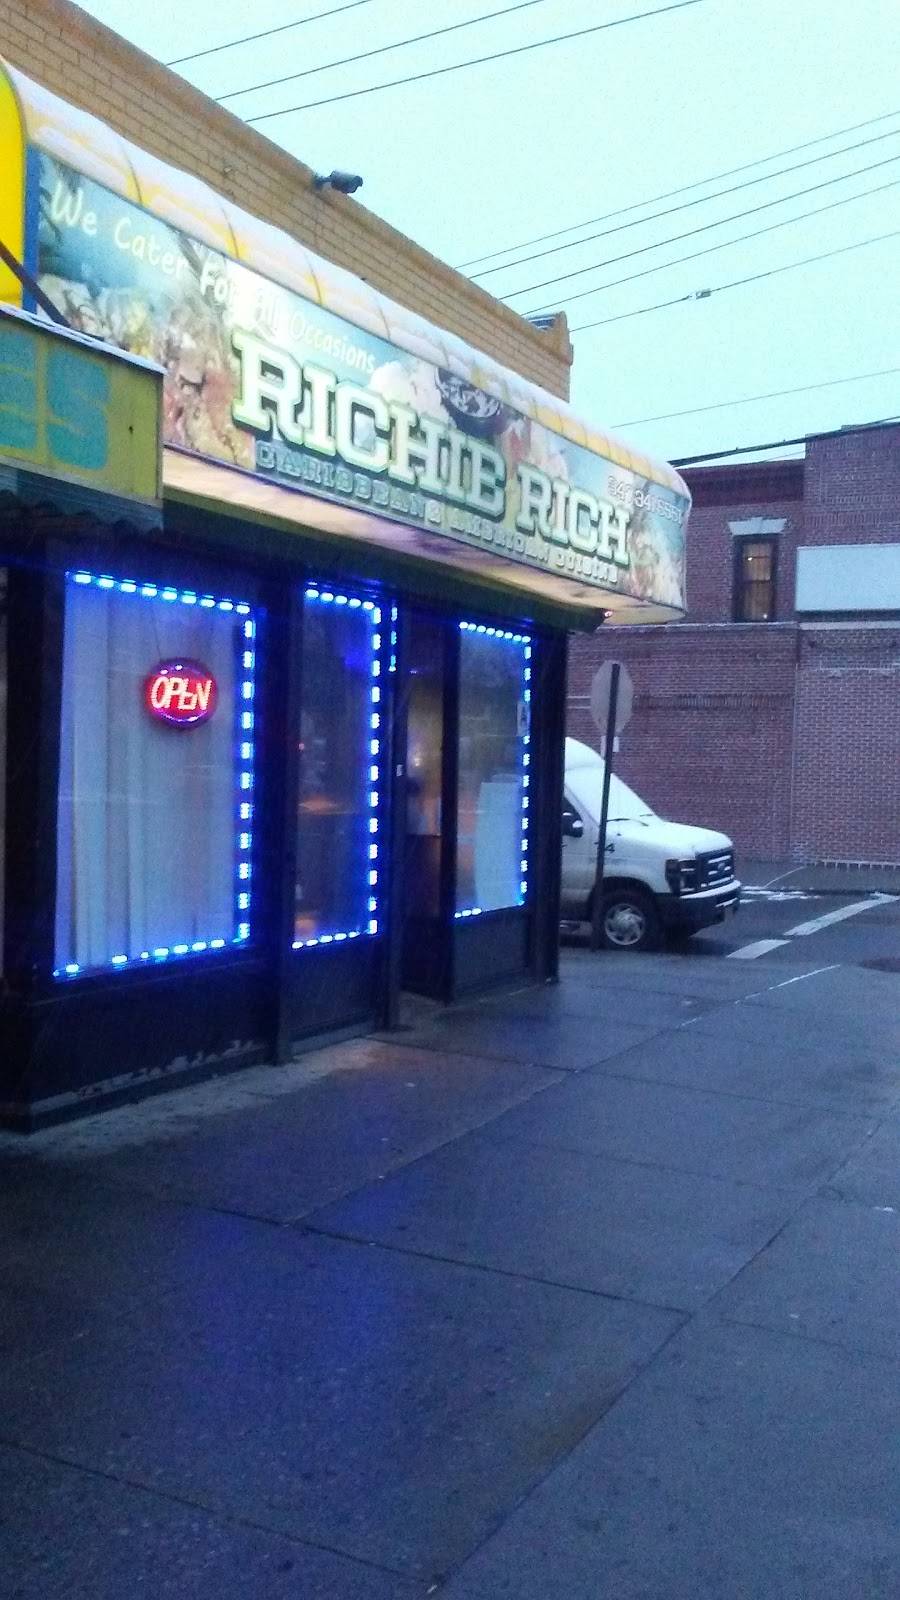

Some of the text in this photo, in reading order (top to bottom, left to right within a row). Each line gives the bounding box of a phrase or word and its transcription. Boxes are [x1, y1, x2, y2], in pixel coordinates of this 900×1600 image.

[51, 179, 98, 236] We
[113, 216, 188, 278] Cater
[288, 312, 377, 376] Occasions
[231, 330, 632, 570] RICHIE RICH
[151, 676, 212, 710] OPEN
